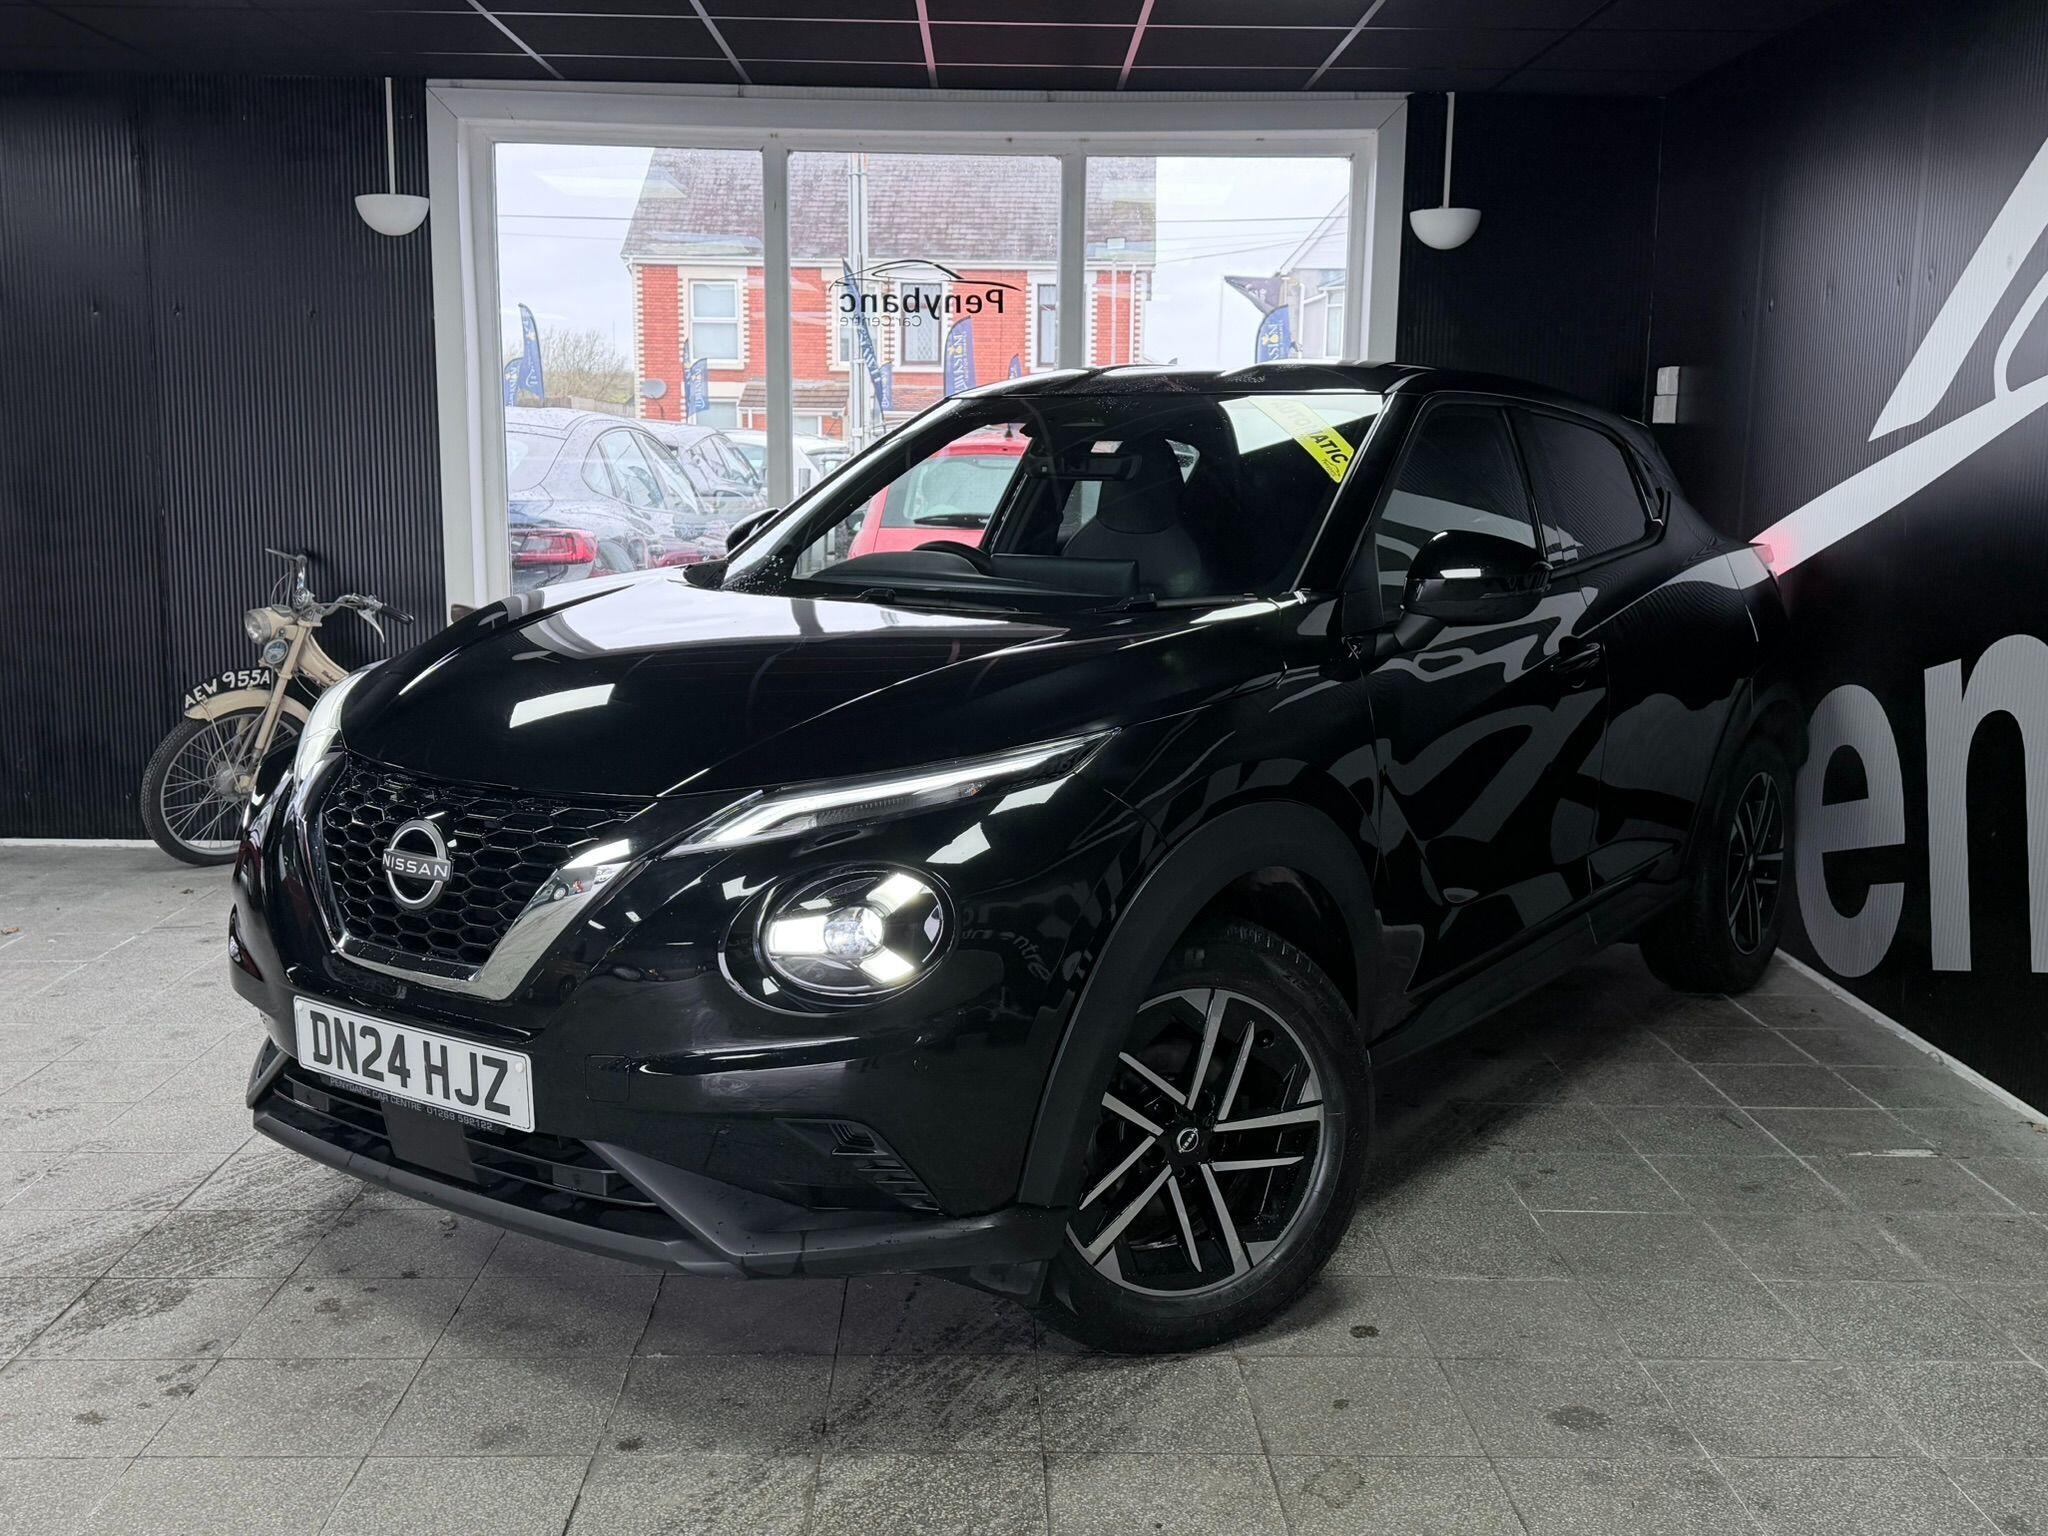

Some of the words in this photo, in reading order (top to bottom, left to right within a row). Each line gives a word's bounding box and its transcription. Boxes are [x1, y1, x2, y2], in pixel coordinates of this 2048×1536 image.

[221, 669, 271, 689] 955A
[382, 852, 449, 878] NISSAN
[309, 1009, 411, 1089] DN24
[423, 1040, 511, 1116] HJZ
[371, 1089, 389, 1103] CAR
[390, 1096, 423, 1113] CENTRE
